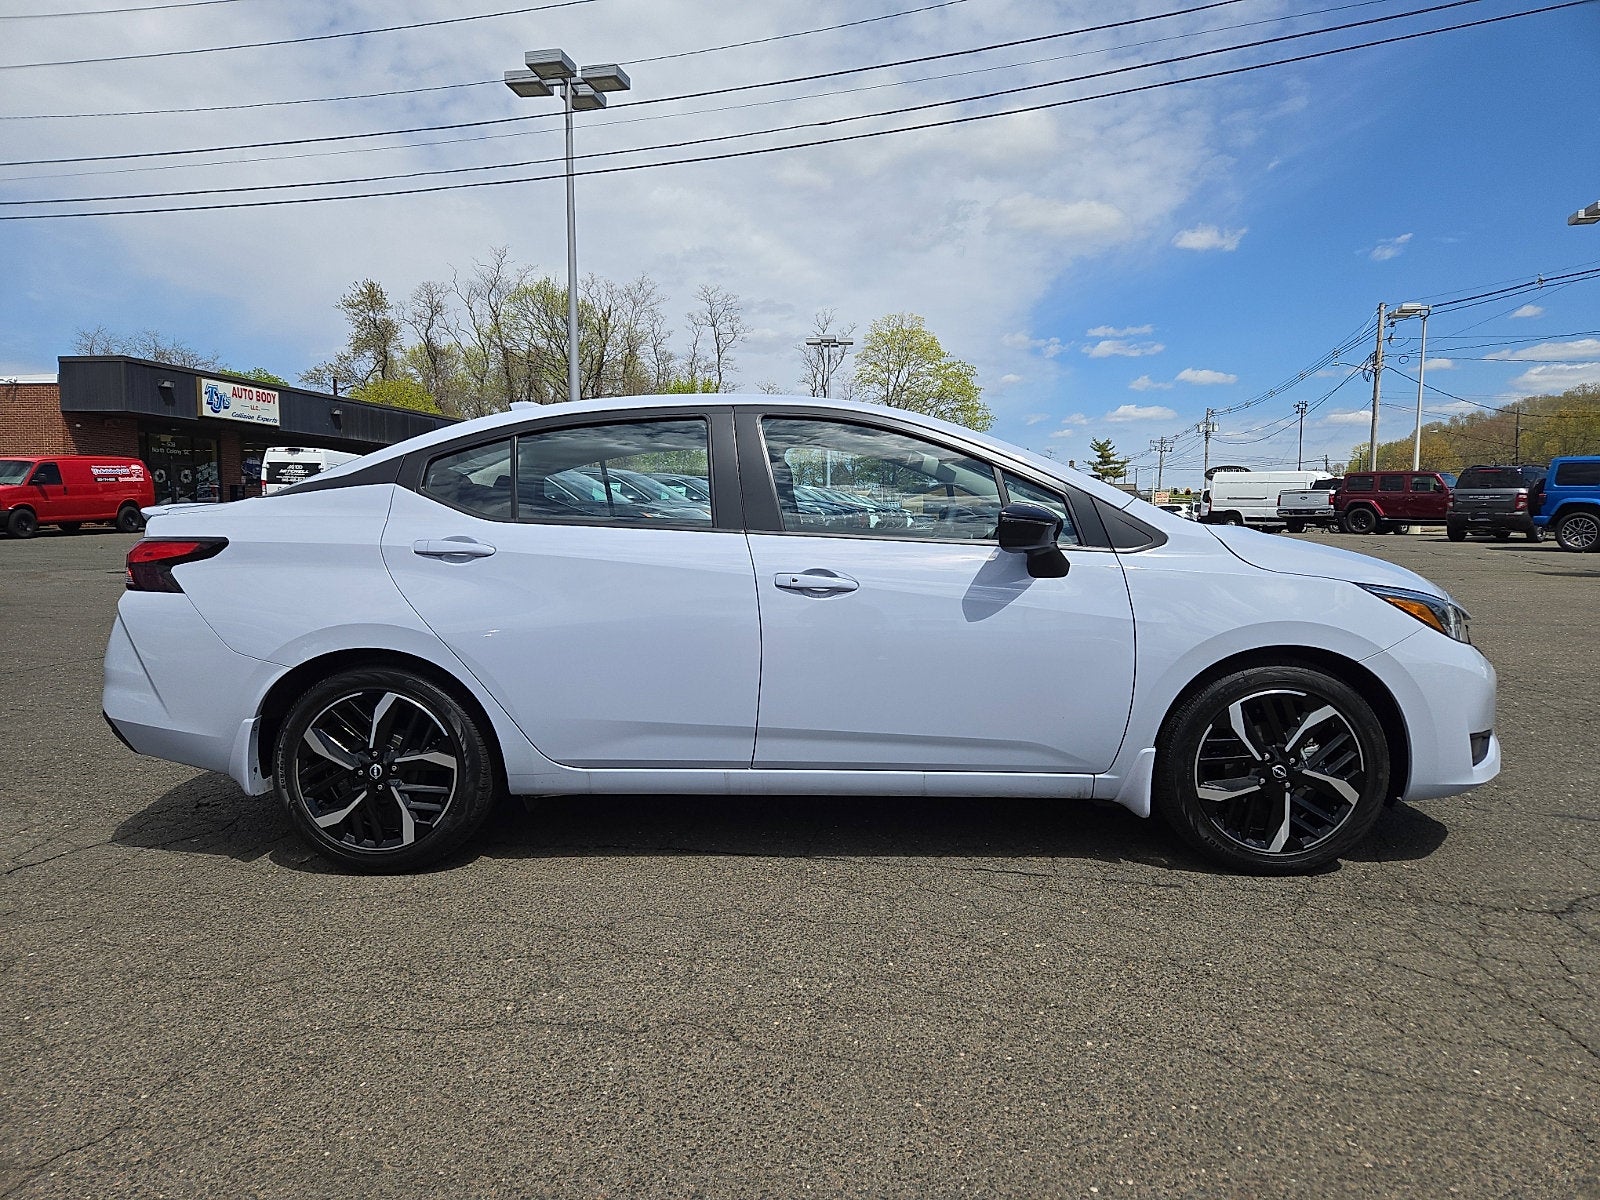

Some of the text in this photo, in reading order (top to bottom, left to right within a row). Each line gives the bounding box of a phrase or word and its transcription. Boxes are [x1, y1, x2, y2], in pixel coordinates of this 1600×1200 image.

[204, 382, 231, 414] TJ's
[231, 386, 277, 405] AUTO BODY
[231, 411, 278, 424] Collision Experts
